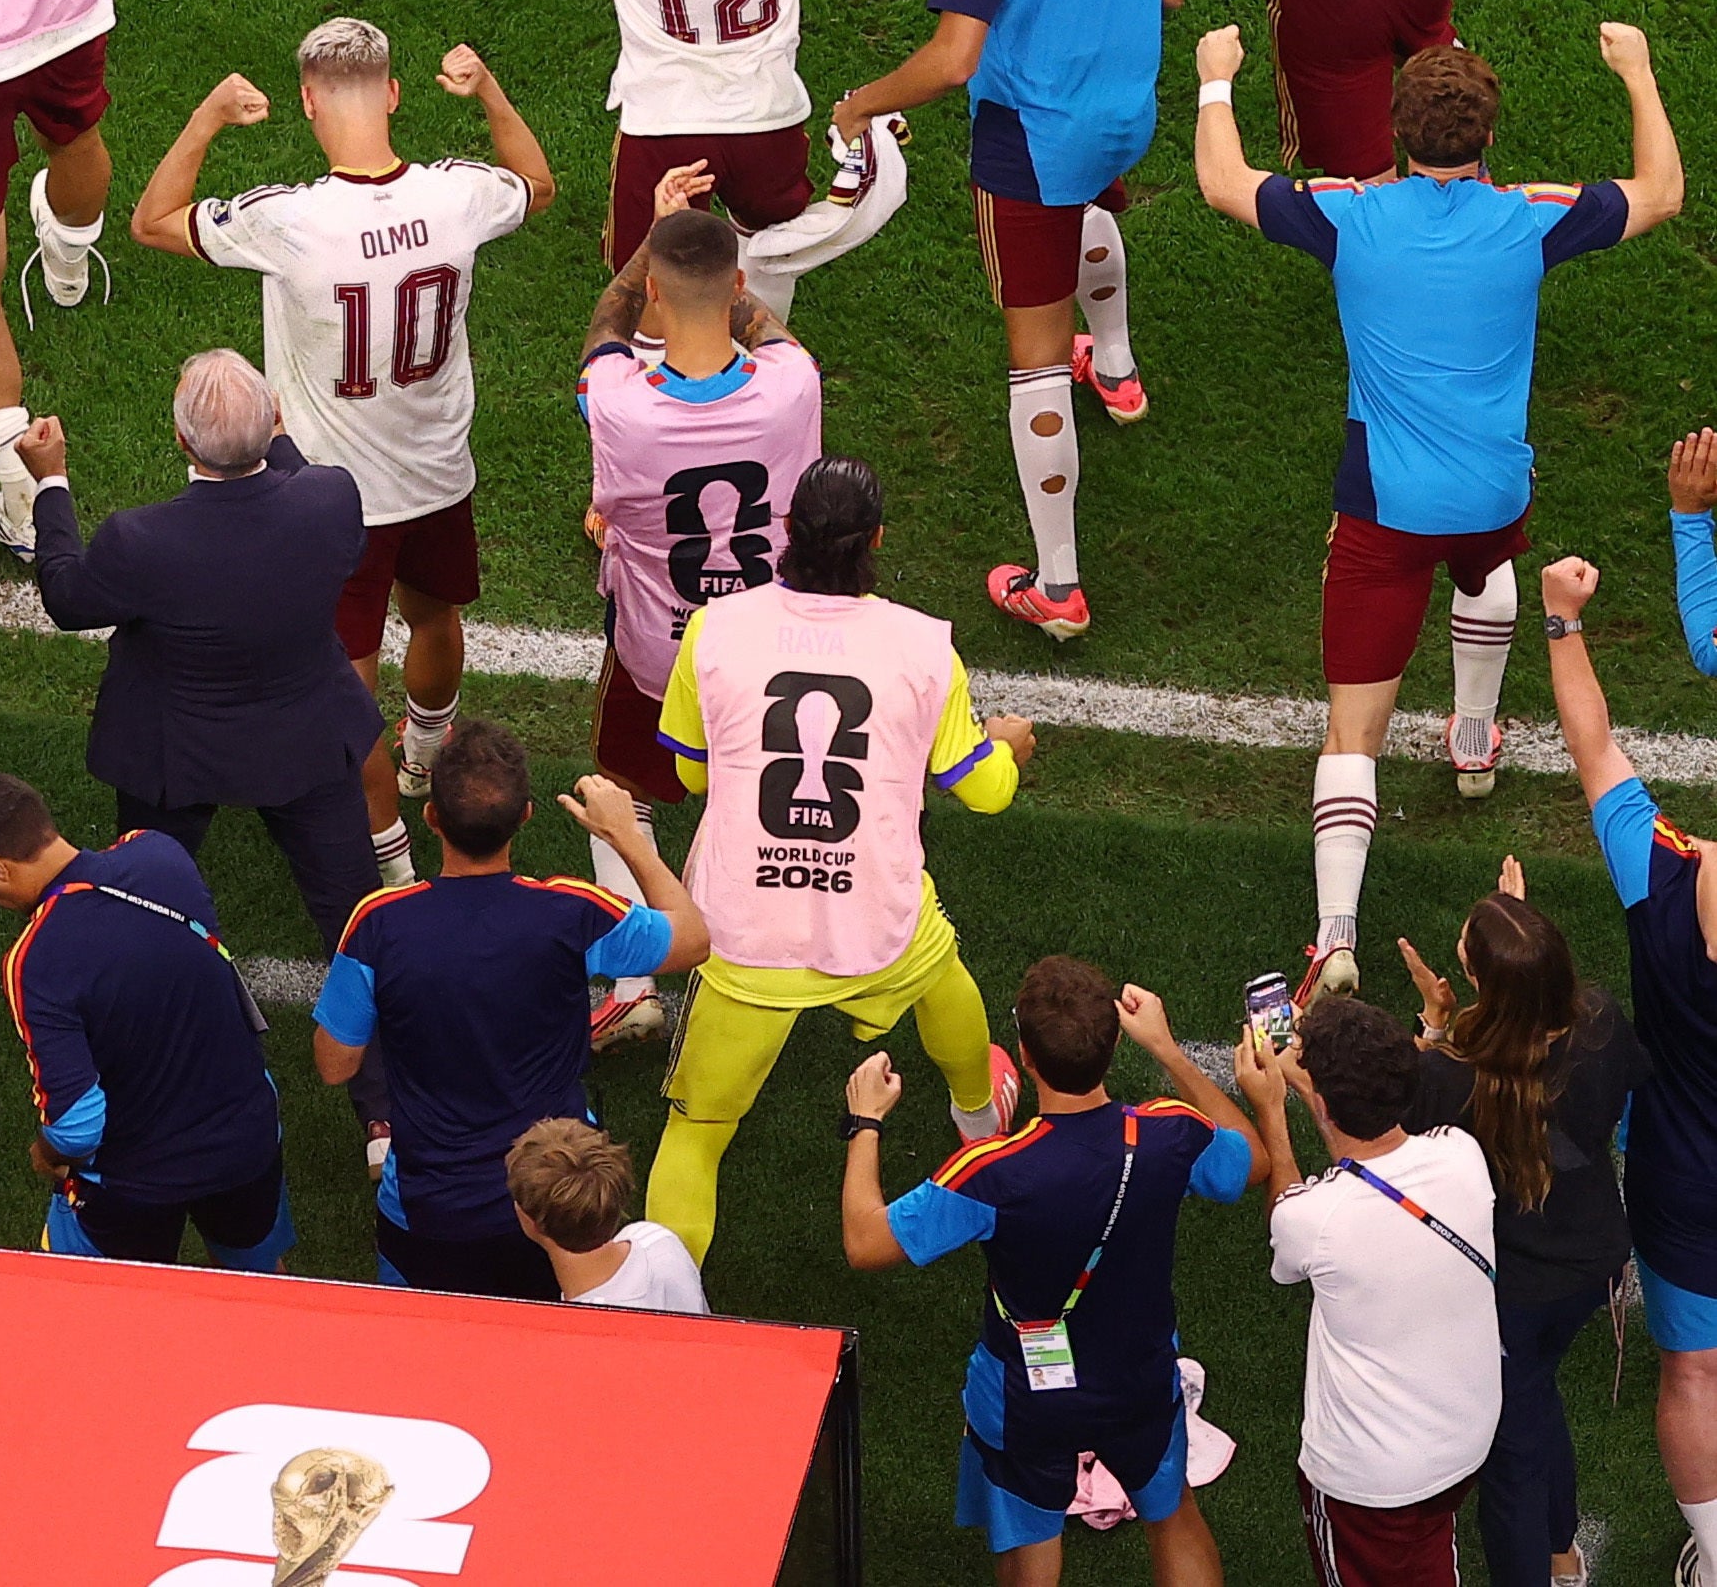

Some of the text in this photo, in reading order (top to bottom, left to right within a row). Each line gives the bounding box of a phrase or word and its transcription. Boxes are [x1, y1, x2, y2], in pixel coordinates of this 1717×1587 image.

[360, 218, 429, 260] OLMO
[334, 263, 461, 400] 10
[699, 576, 746, 594] FIFA
[777, 626, 847, 656] RAYA
[788, 806, 834, 829] FIFA
[757, 846, 856, 867] WORLD CUP
[755, 865, 853, 894] 2026
